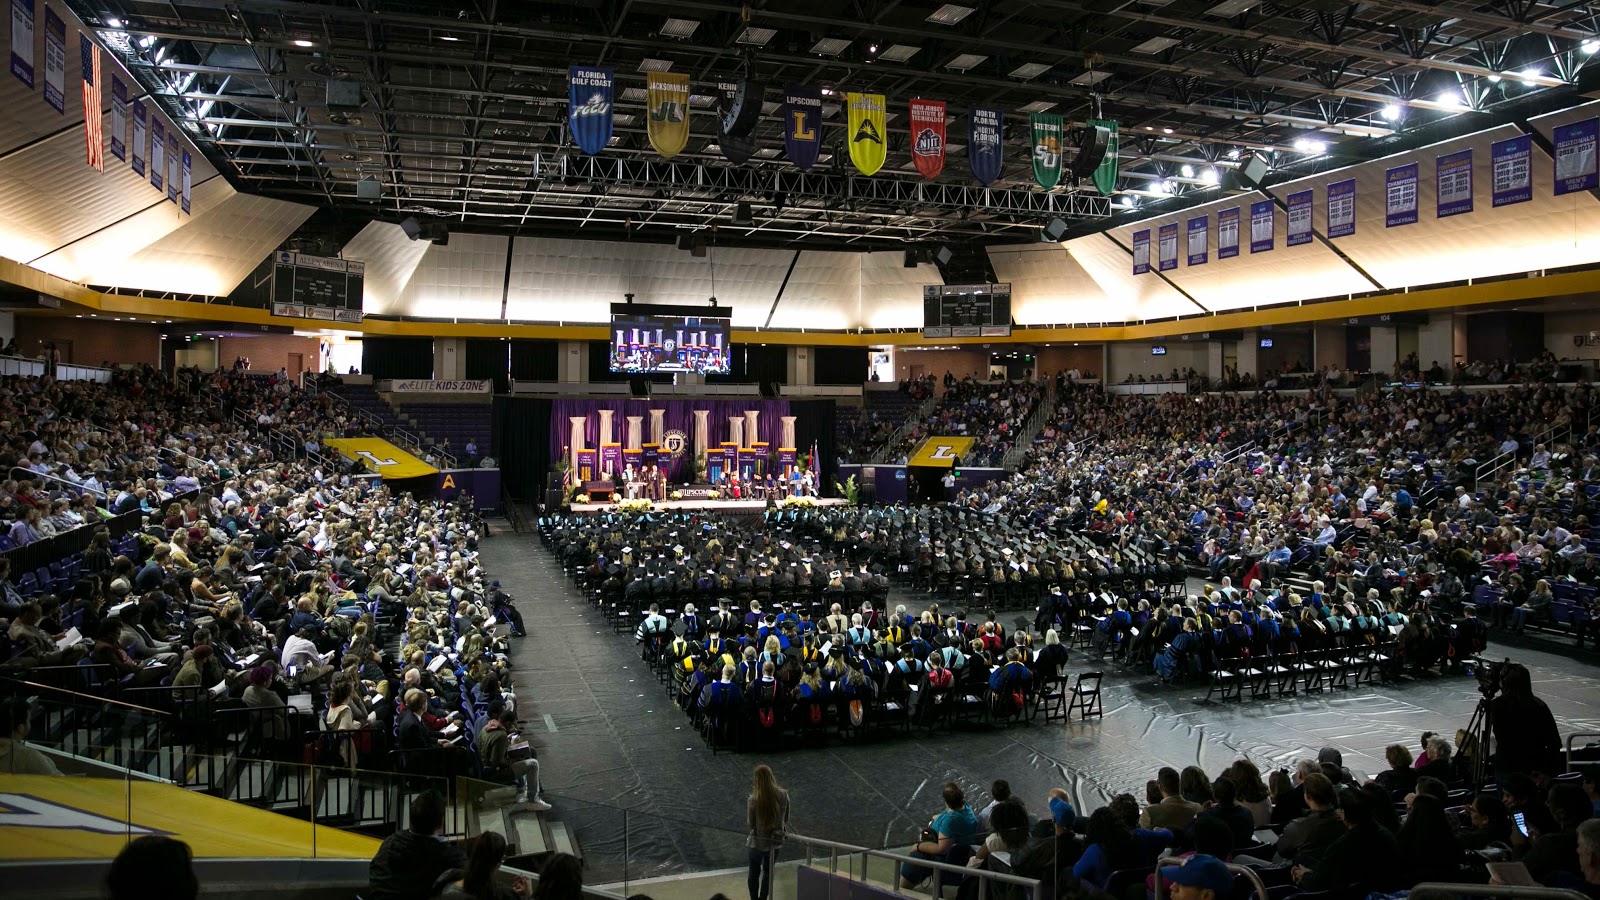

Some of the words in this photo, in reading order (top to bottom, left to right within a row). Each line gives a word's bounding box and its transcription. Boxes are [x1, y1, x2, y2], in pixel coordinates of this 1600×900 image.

[577, 70, 606, 80] FLORIDA
[572, 78, 588, 86] GULF
[590, 79, 612, 88] COAST
[649, 82, 688, 92] JACKSONVILLE
[786, 96, 821, 106] LIPSCOMB
[571, 103, 610, 118] FGCU
[650, 102, 688, 122] JU
[976, 109, 996, 119] NORTH
[792, 109, 816, 141] L
[974, 117, 998, 126] FLORIDA
[1034, 122, 1060, 132] STETSON
[974, 132, 999, 144] FLORIDA
[1557, 135, 1595, 149] REGIONALS
[920, 138, 939, 150] NJIT
[1578, 144, 1593, 152] 2017
[1033, 144, 1060, 168] SU
[1494, 150, 1530, 163] TOURNAMENT
[1438, 164, 1471, 176] CHAMPIONS
[1387, 177, 1417, 188] CHAMPIONS
[1329, 192, 1354, 201] CHAMPIONS
[1495, 193, 1529, 204] VOLLEYBALL
[1288, 202, 1311, 210] CHAMPIONS
[1440, 205, 1471, 215] VOLLEYBALL
[1388, 216, 1416, 225] VOLLEYBALL
[300, 257, 321, 266] ALLEN
[323, 261, 344, 269] ARENA
[410, 381, 436, 390] ELITE
[436, 381, 458, 390] KIDS
[460, 381, 484, 390] ZONE
[354, 450, 400, 466] L
[929, 445, 957, 460] L
